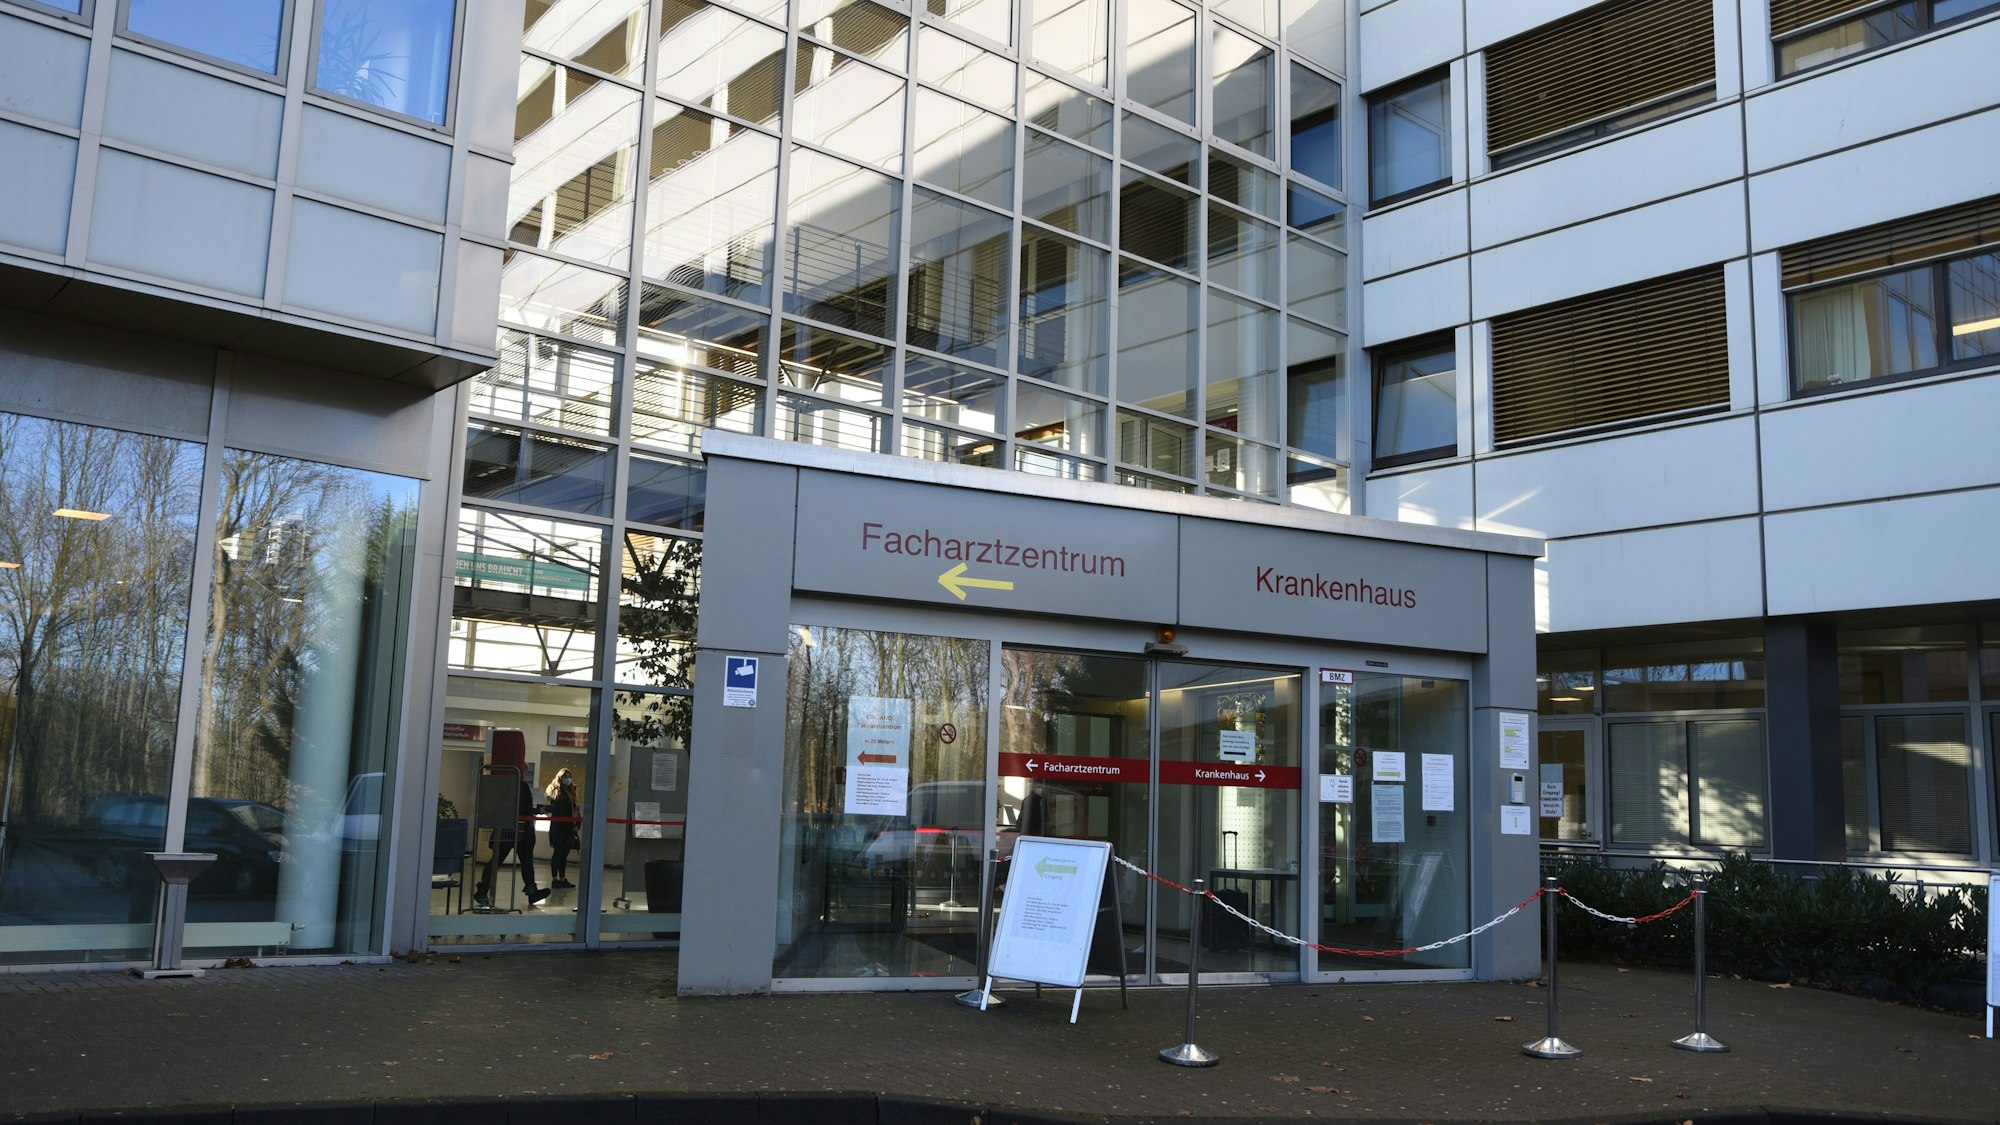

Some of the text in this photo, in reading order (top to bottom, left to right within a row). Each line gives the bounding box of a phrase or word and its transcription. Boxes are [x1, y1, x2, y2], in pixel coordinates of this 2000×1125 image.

[861, 522, 1125, 577] Facharztzentrum
[470, 560, 486, 572] UNS
[488, 563, 524, 577] BRAUCHT.
[1256, 566, 1416, 609] Krankenhaus
[1329, 672, 1346, 681] BMZ
[856, 722, 903, 730] Facharztzentrum
[1043, 762, 1120, 775] Facharztzentrum
[1195, 768, 1250, 780] Krankenhaus
